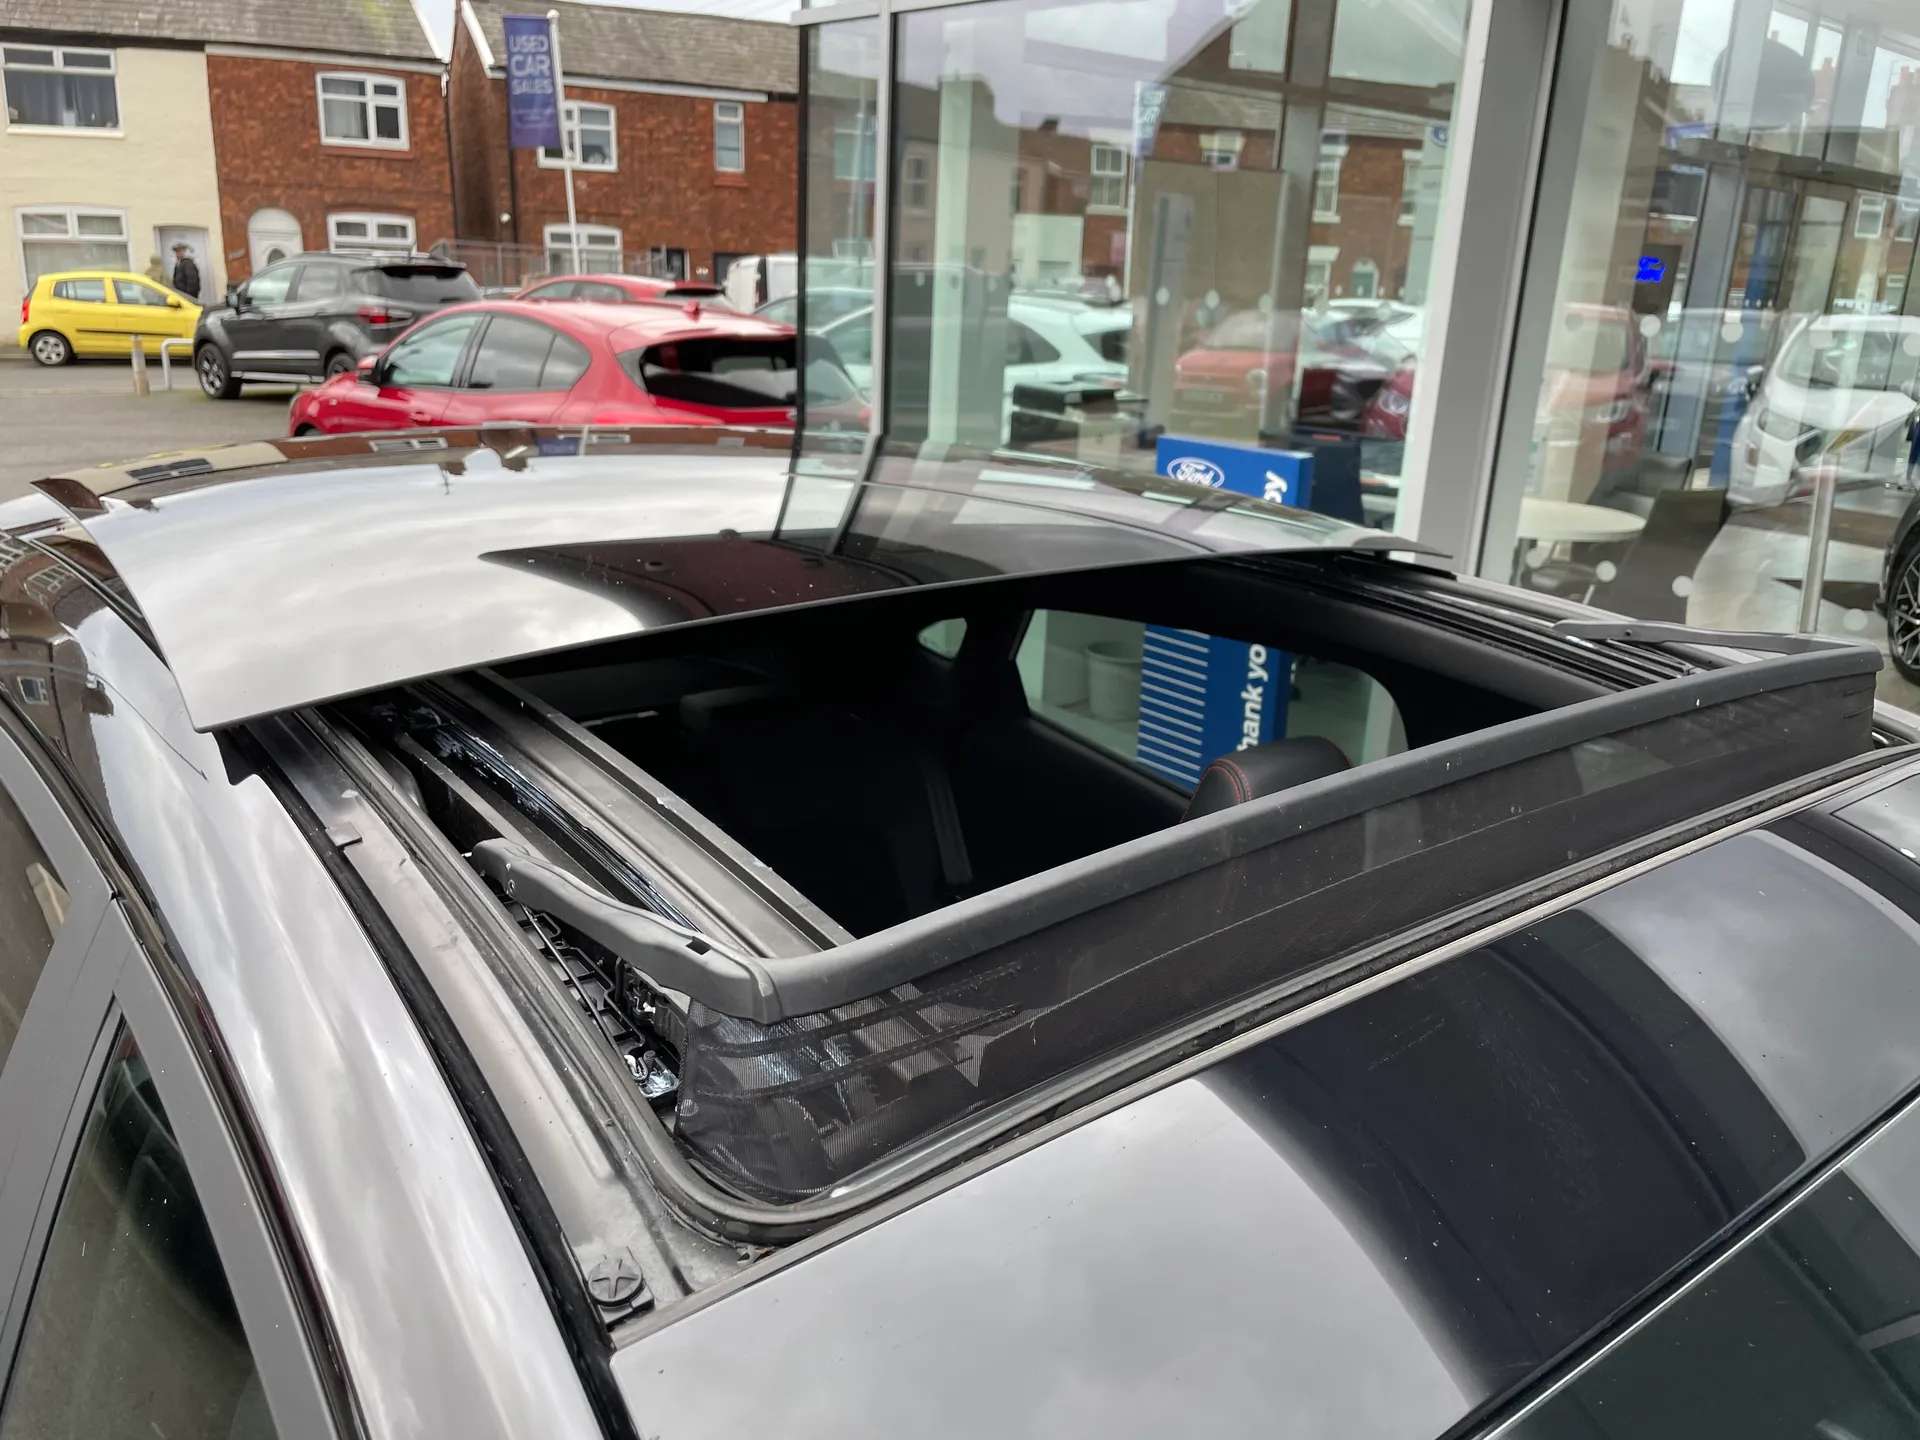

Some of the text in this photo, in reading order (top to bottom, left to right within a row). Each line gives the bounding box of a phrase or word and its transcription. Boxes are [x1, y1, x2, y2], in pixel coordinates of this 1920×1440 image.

[508, 34, 549, 53] USED
[510, 53, 551, 77] CAR
[511, 78, 553, 95] SALES
[1236, 643, 1268, 751] hank yo
